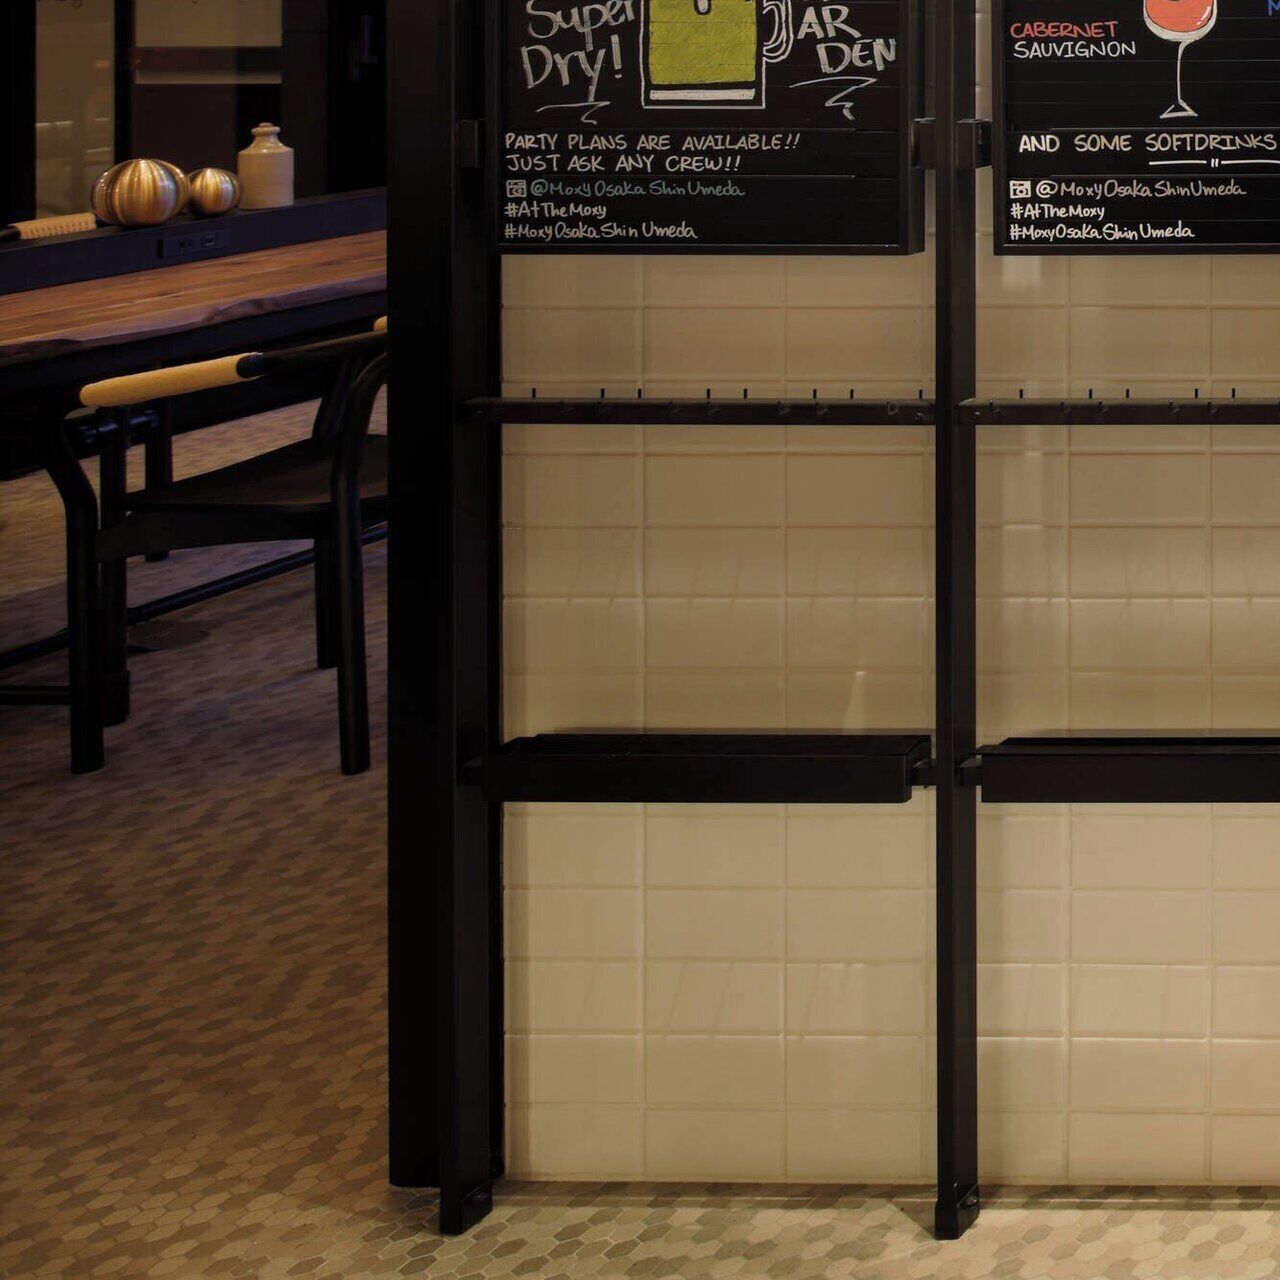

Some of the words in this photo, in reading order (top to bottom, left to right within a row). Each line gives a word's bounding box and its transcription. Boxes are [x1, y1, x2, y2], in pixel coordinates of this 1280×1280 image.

[797, 5, 862, 40] AR
[1010, 21, 1119, 39] CABERNET
[816, 38, 896, 73] DEN
[1013, 40, 1137, 58] SAUVIGNON
[519, 34, 623, 104] Dry!
[505, 133, 558, 151] PARTY
[568, 134, 628, 151] PLANS
[637, 135, 671, 151] ARE
[682, 132, 801, 151] AVAILABLE!!
[1018, 134, 1060, 153] AND
[1074, 134, 1132, 152] SOME
[1144, 134, 1278, 151] SOFTDRINKS
[507, 154, 559, 172] JUST
[567, 154, 605, 172] ASK
[615, 154, 655, 172] ANY
[666, 154, 741, 171] CREW!!
